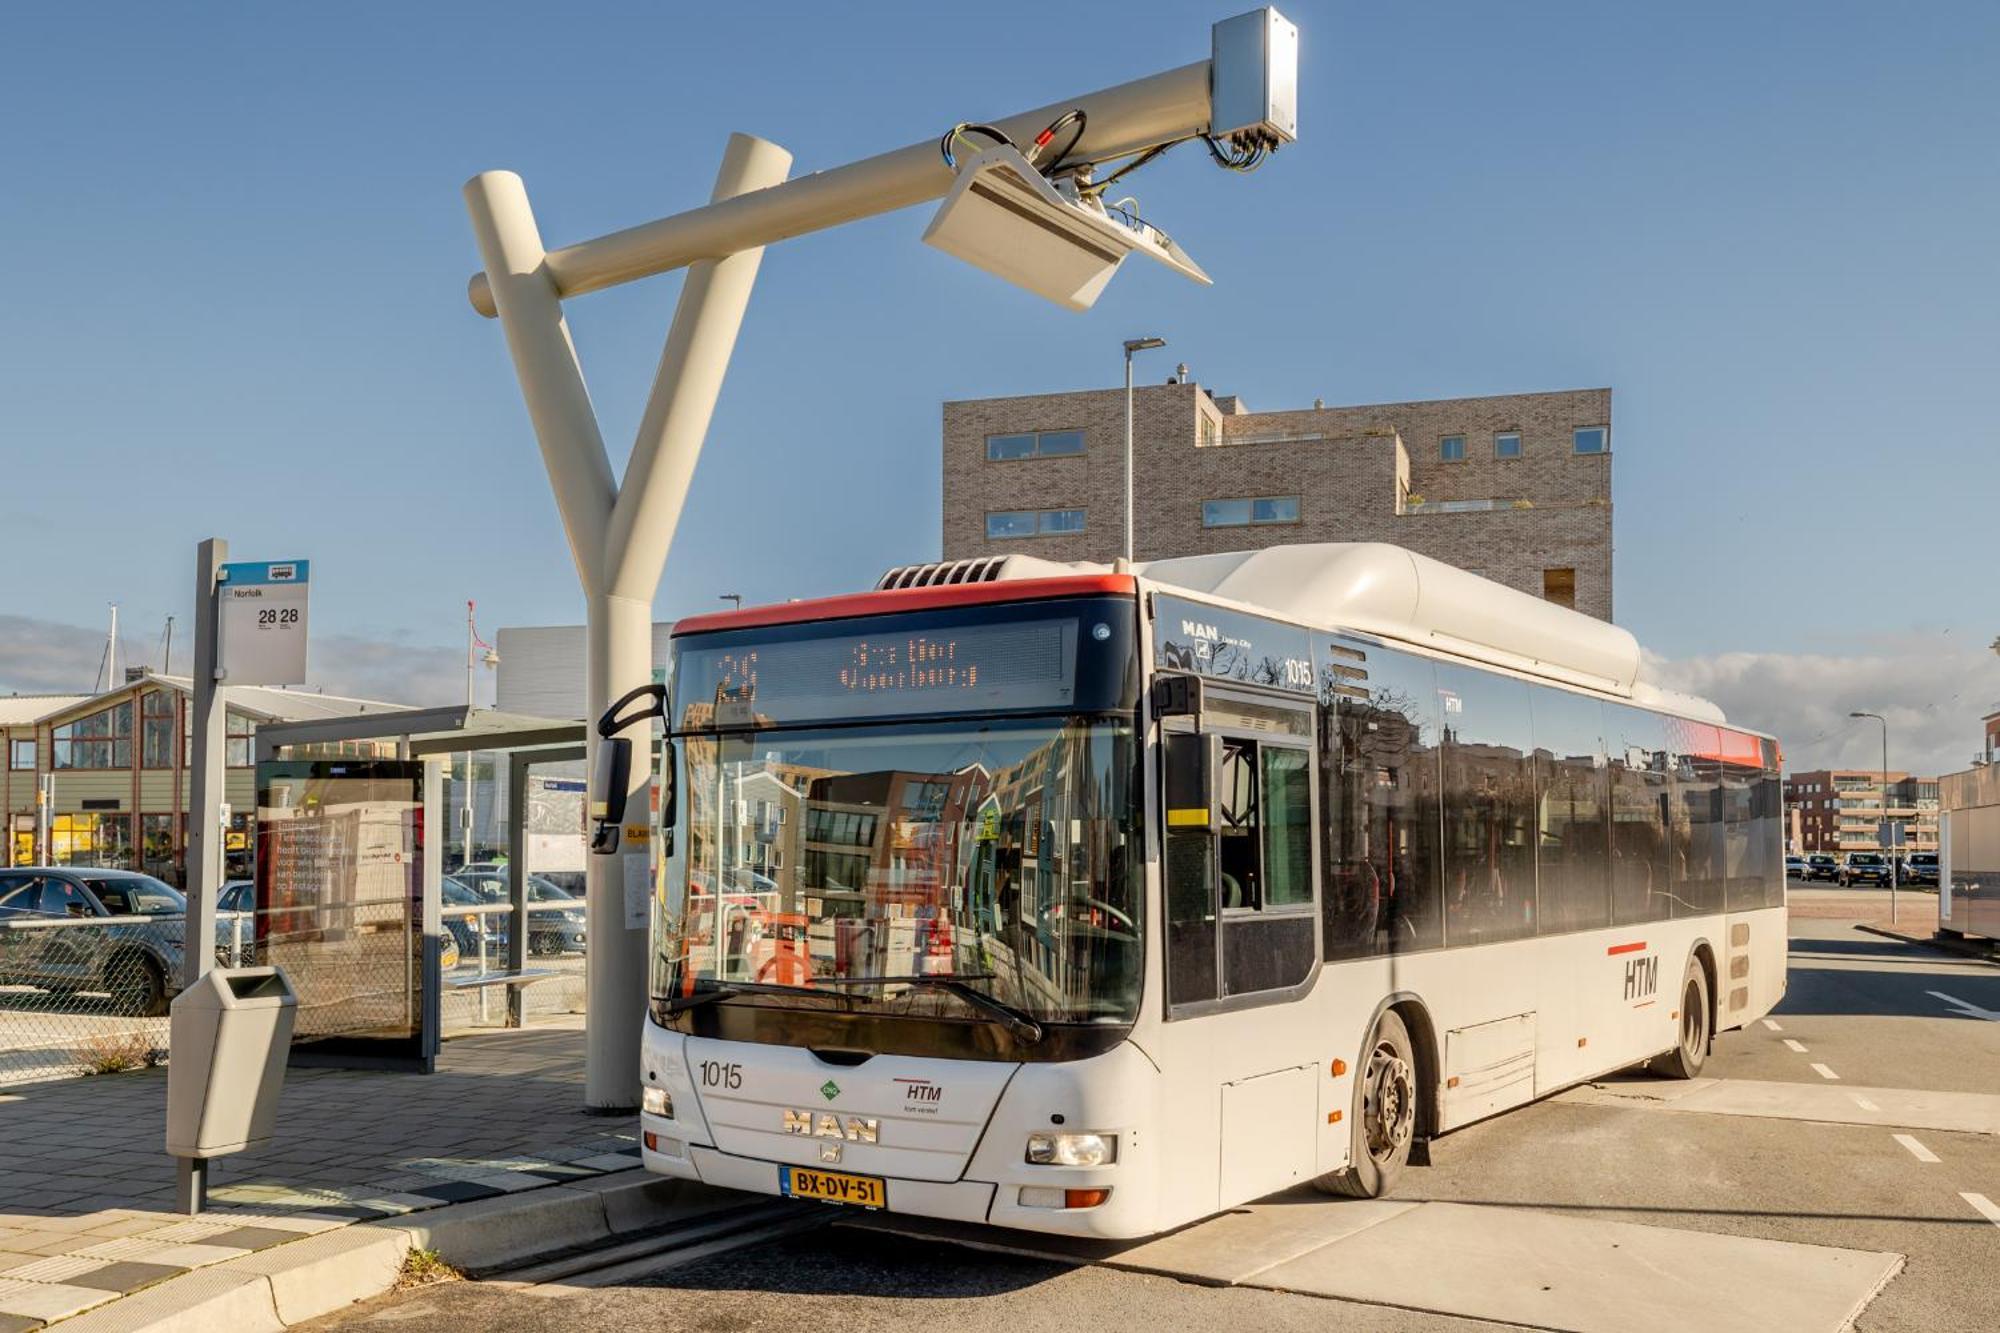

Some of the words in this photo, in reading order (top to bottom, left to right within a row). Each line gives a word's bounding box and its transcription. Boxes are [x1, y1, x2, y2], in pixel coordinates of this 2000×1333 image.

[234, 589, 262, 598] Norfolk
[258, 609, 277, 624] 28
[280, 608, 298, 623] 28
[1181, 619, 1218, 642] MAN
[1285, 657, 1311, 686] 1015
[1445, 696, 1462, 713] HTM
[1623, 955, 1658, 1001] HTM
[699, 1060, 742, 1090] 1015
[906, 1084, 942, 1102] HTM
[783, 1109, 879, 1144] MAN
[797, 1172, 876, 1202] BX-DV-51
